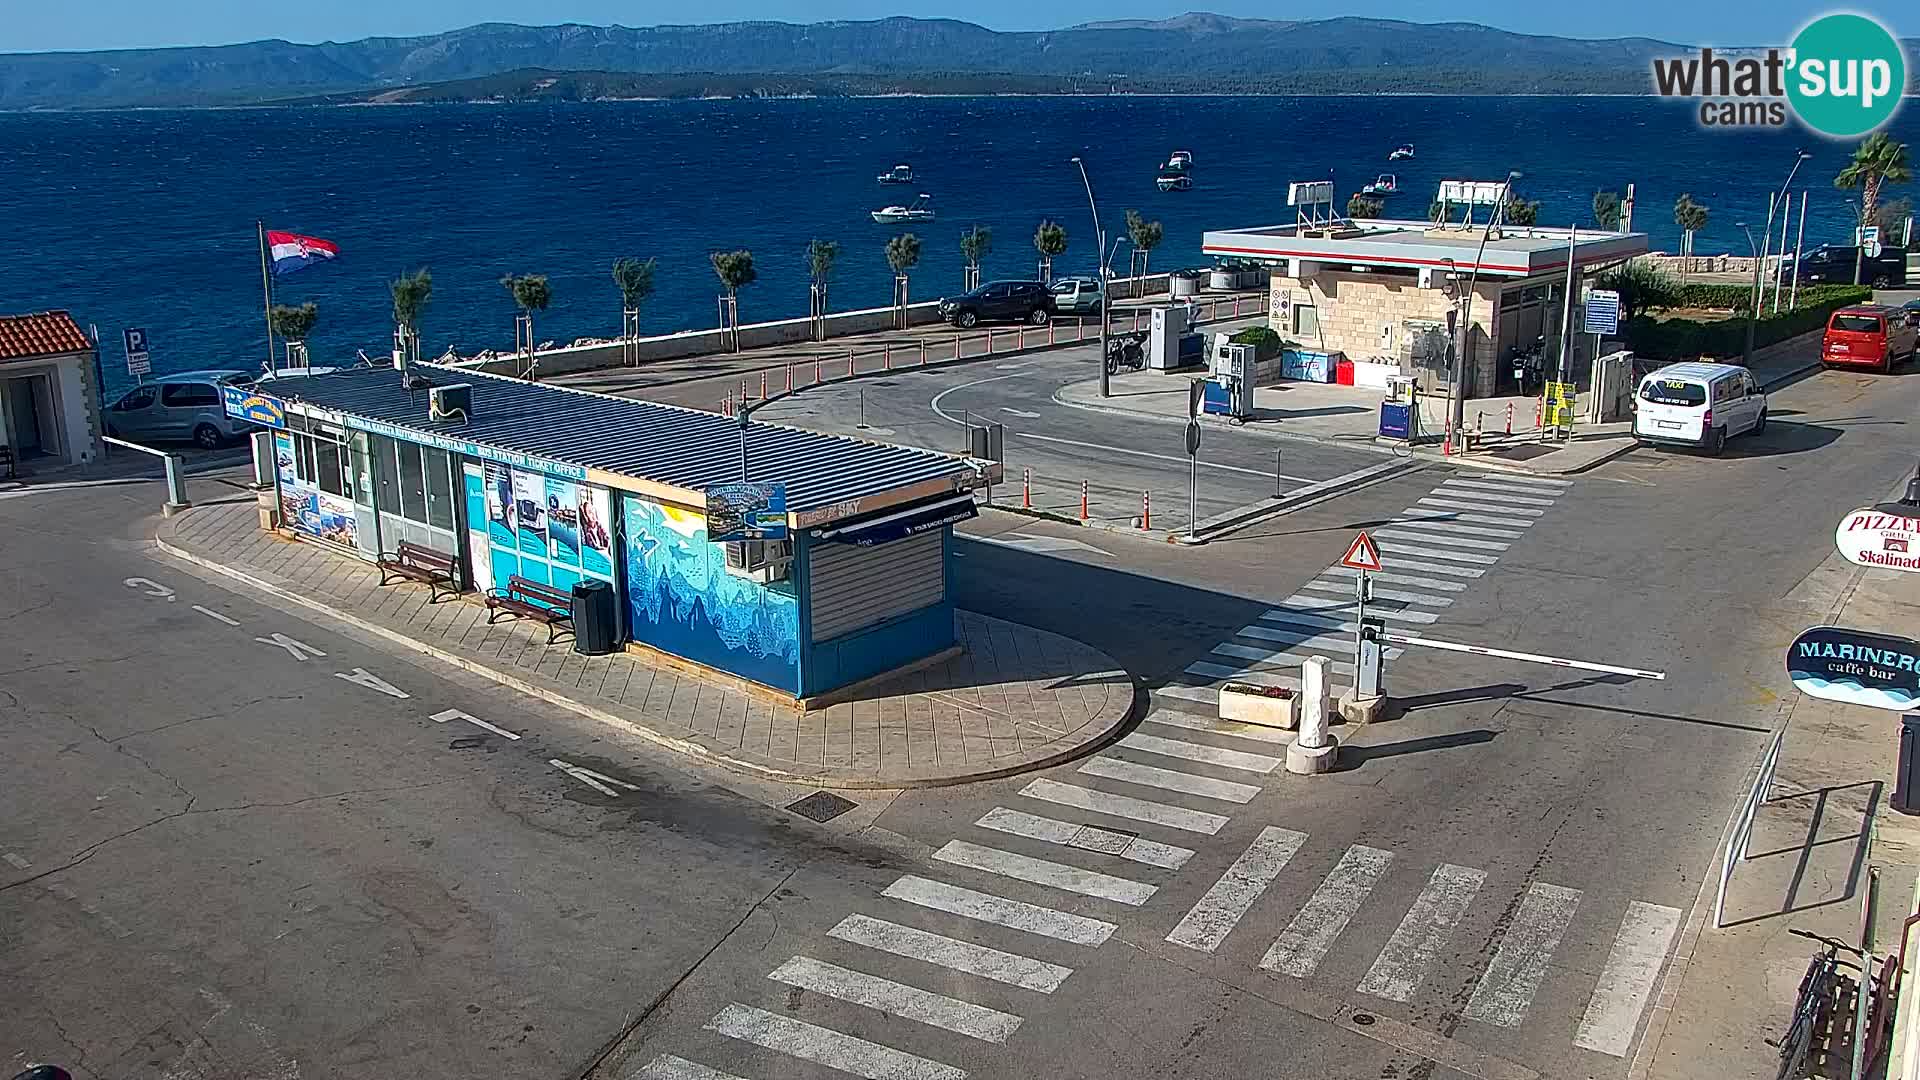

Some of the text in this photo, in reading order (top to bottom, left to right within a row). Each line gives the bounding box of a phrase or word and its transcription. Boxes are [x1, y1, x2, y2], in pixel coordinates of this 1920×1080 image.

[130, 332, 141, 350] P
[1665, 380, 1685, 389] TAXI
[436, 437, 465, 451] POSTAJA
[477, 447, 493, 458] BUS
[493, 449, 525, 465] STATION
[527, 457, 552, 472] TICKET
[554, 463, 581, 478] OFFICE
[1848, 515, 1920, 533] PIZZE
[1880, 530, 1915, 541] GRILL
[1828, 662, 1895, 680] caffe bar
